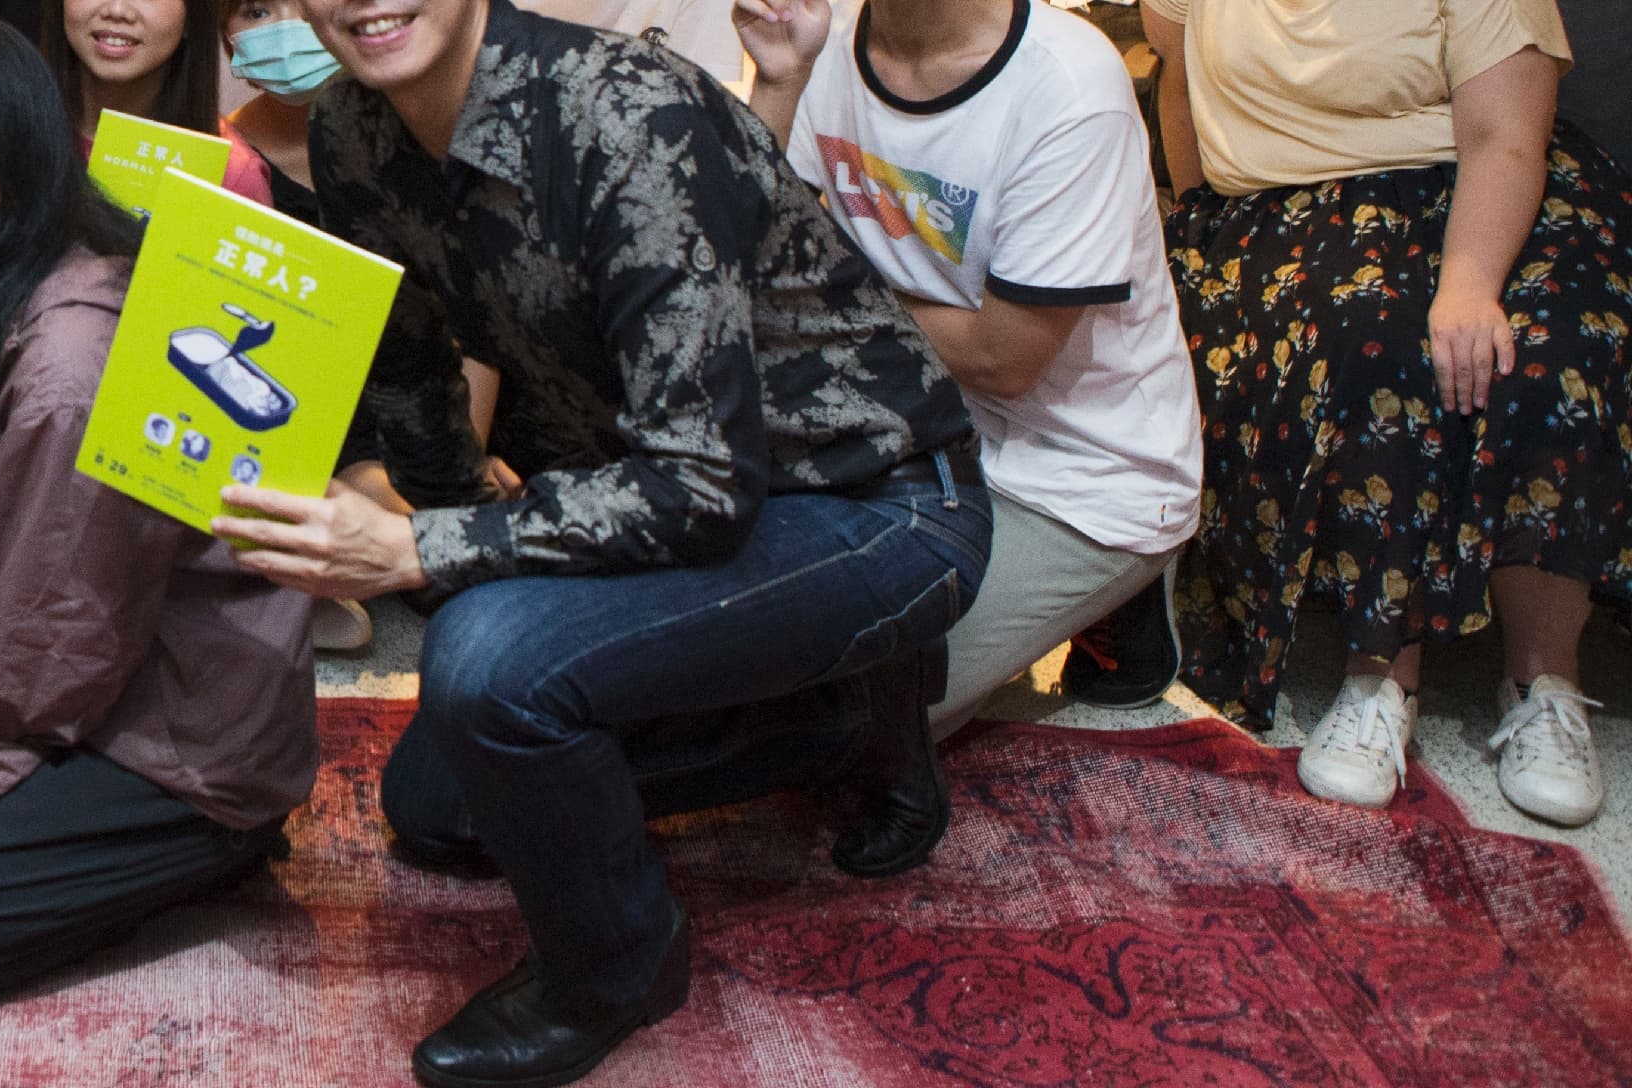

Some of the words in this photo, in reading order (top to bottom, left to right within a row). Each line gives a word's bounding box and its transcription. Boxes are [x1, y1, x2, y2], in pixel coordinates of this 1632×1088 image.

[103, 153, 155, 176] NORMAL
[136, 140, 184, 168] 正常人
